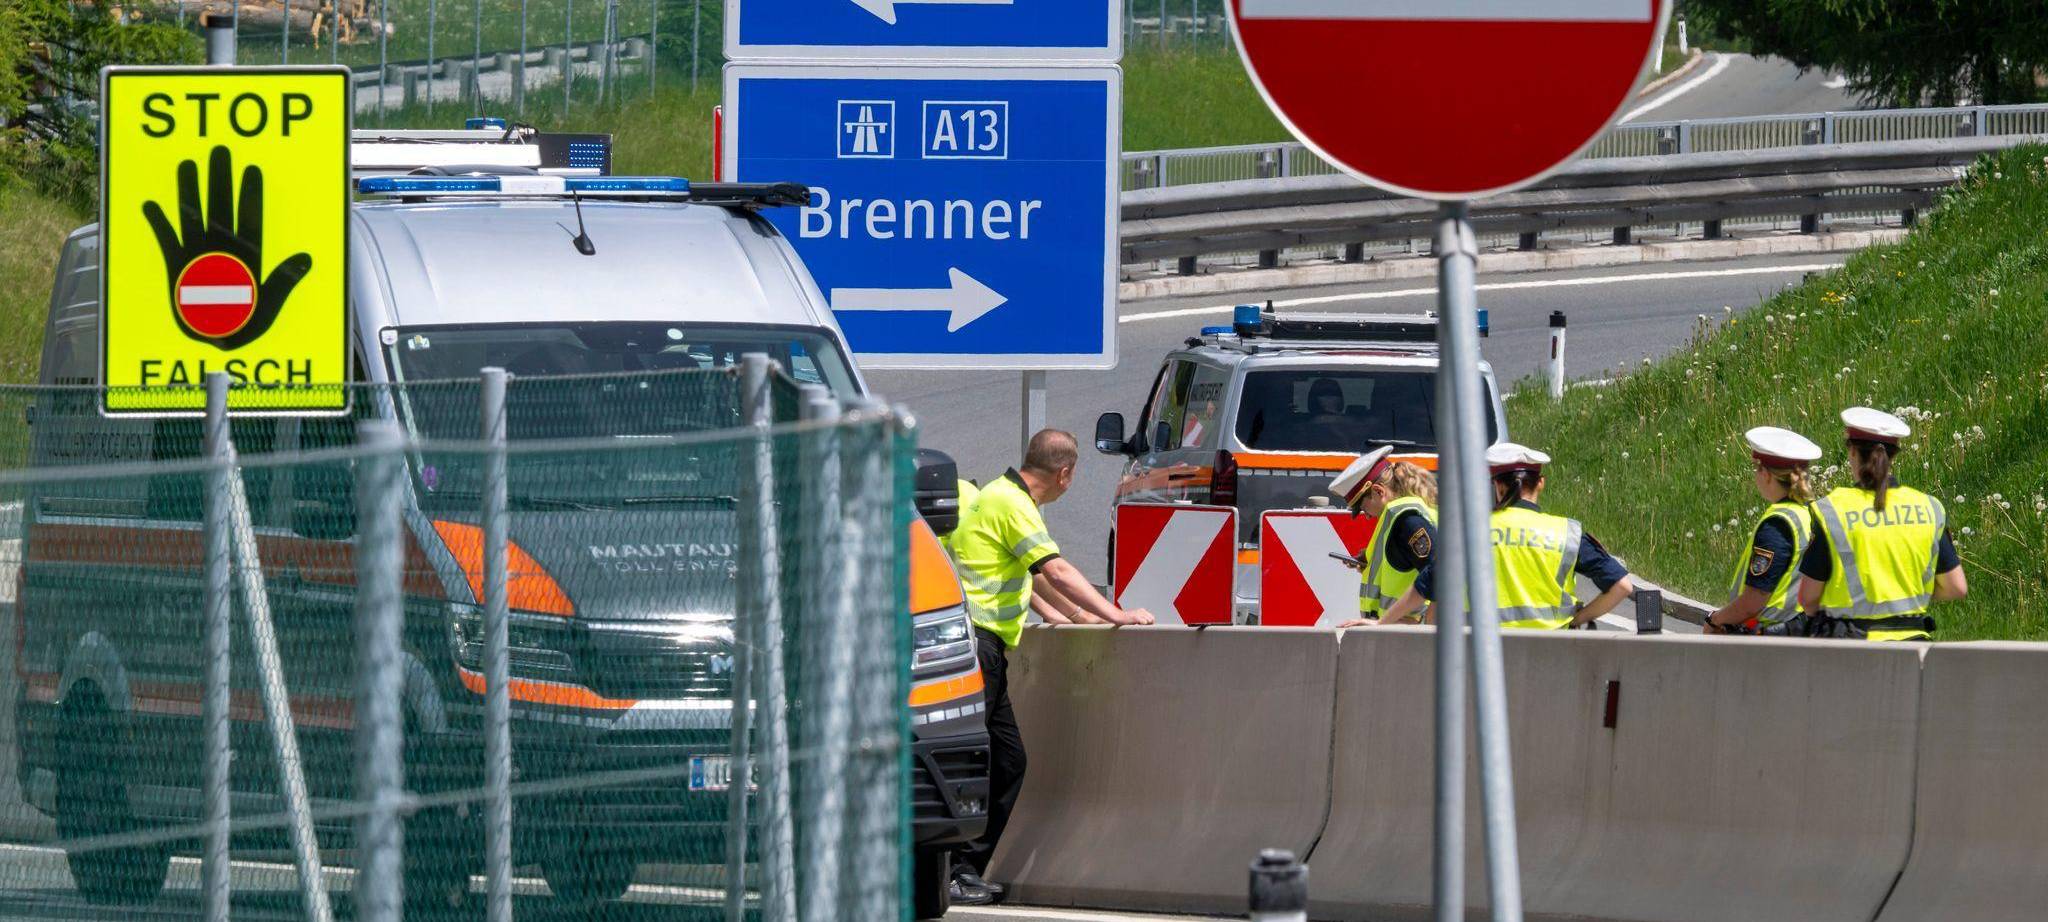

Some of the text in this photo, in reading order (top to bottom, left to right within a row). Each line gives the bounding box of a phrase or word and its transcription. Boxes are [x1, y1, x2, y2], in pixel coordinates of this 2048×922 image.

[141, 92, 313, 138] STOP
[932, 109, 998, 151] A13
[799, 186, 1042, 240] Brenner
[1845, 504, 1933, 531] POLIZEI
[588, 543, 738, 558] MAUTAU
